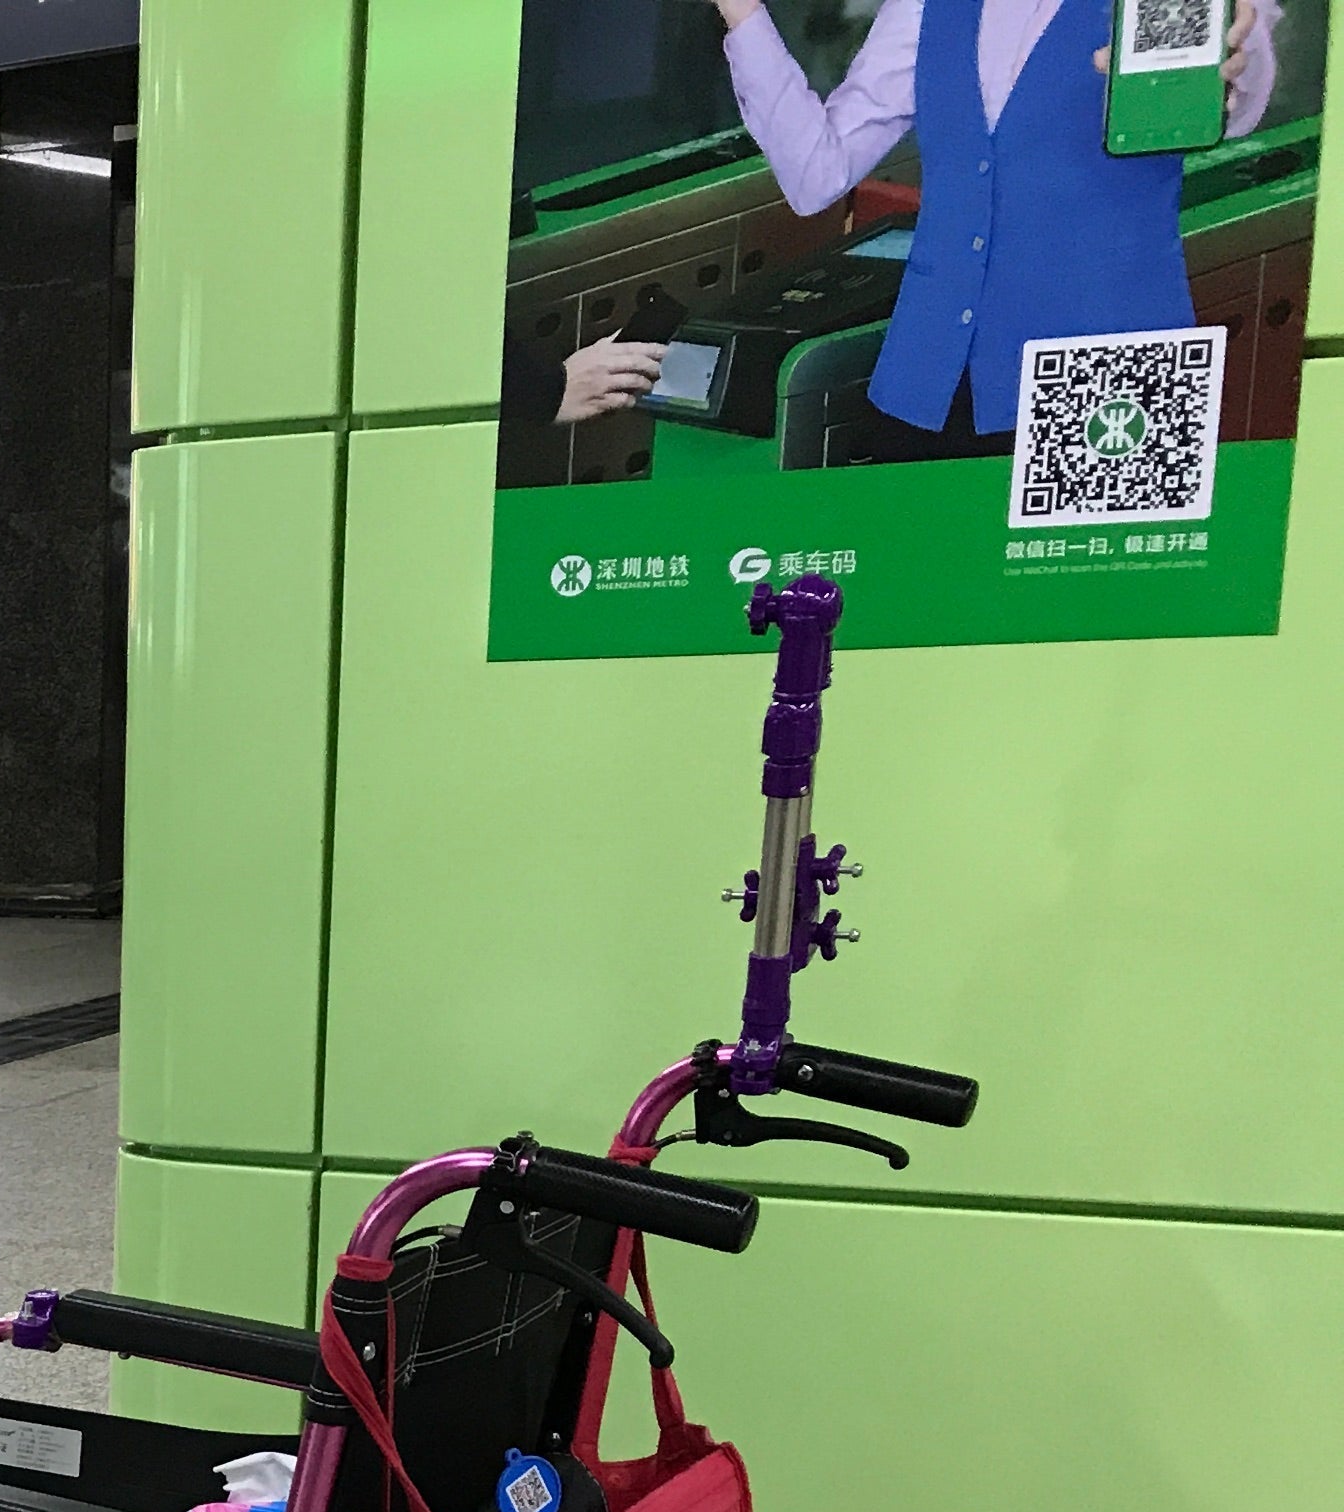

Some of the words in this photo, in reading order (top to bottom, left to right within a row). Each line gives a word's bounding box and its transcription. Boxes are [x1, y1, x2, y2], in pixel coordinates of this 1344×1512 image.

[596, 554, 691, 581] 深圳地铁
[778, 549, 857, 577] 乘车码
[595, 580, 650, 591] SHENZHEN
[653, 578, 689, 589] METRO
